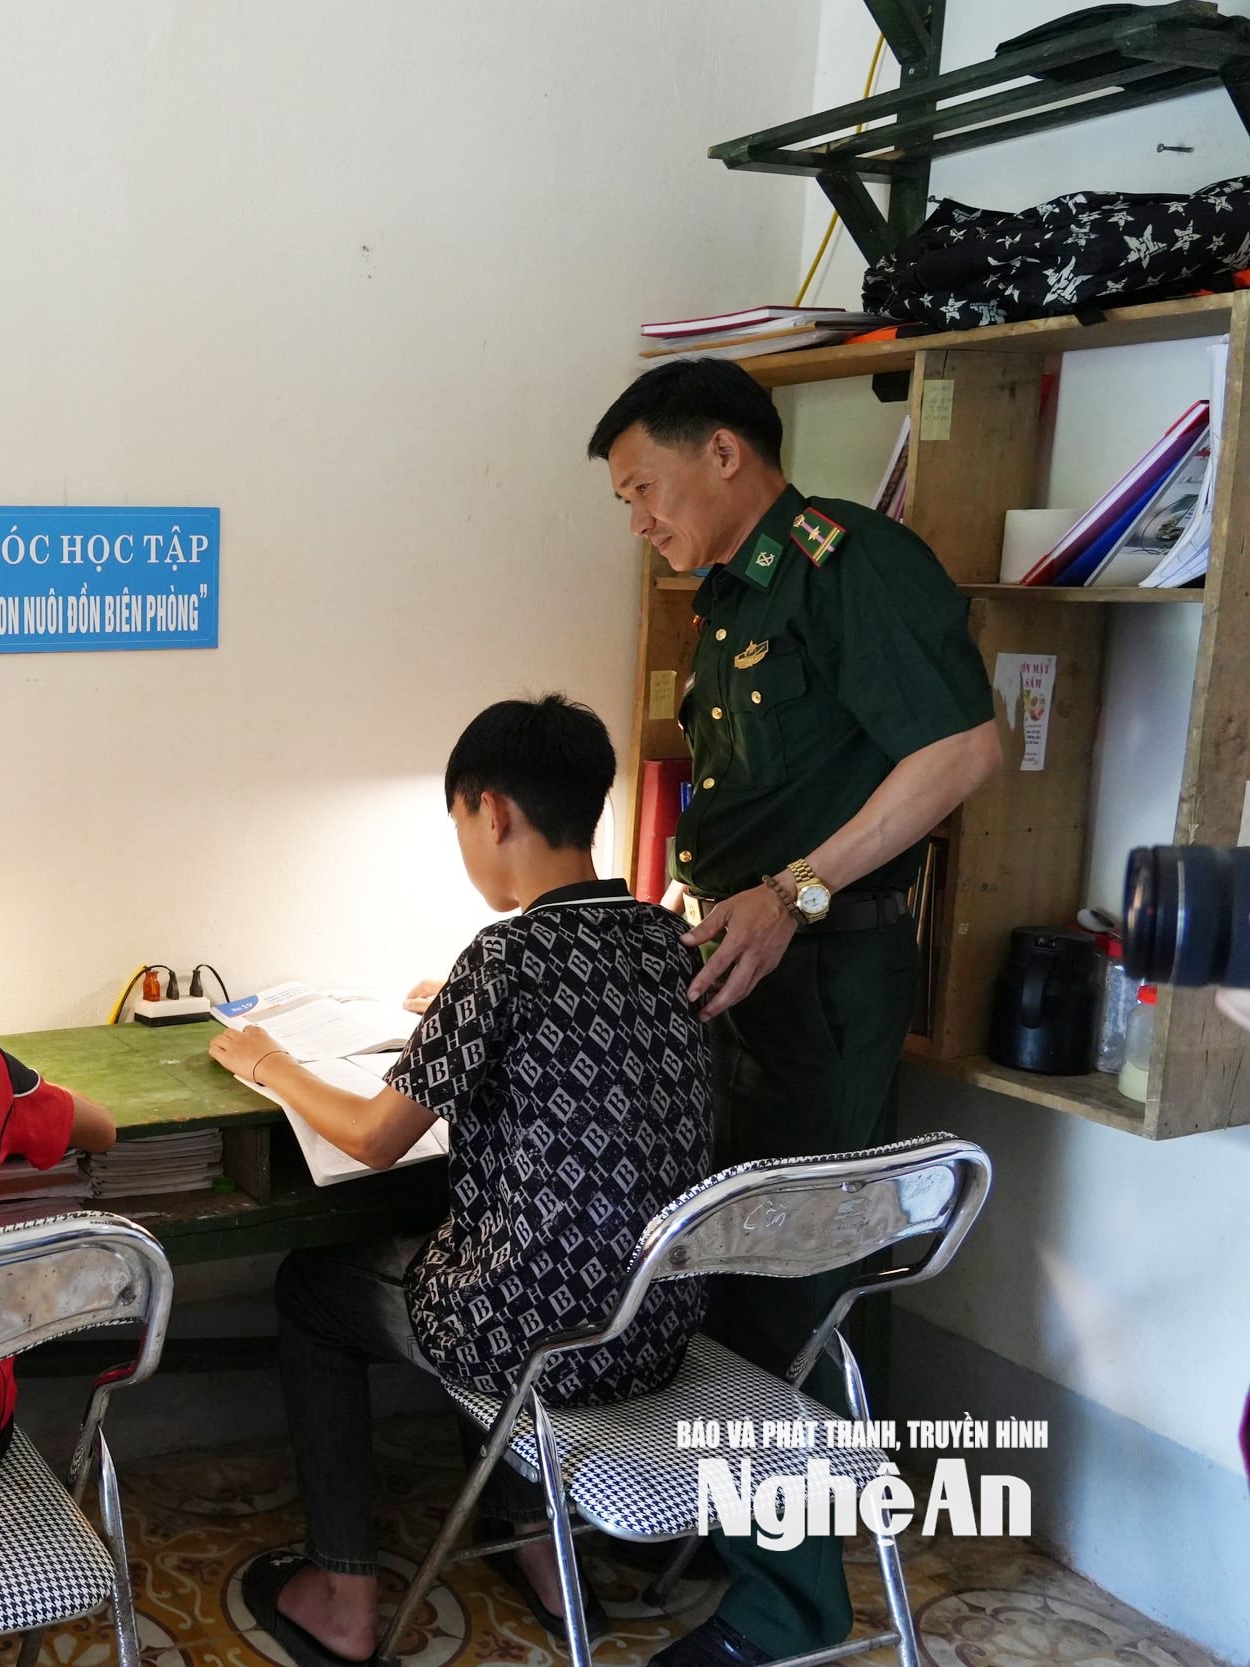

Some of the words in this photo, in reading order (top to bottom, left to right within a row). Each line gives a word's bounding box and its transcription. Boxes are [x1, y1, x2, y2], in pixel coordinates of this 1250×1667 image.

[60, 534, 134, 573] HỌC
[143, 525, 209, 571] TẬP
[23, 588, 63, 634] NUÔI
[67, 582, 101, 634] ĐỒN
[104, 587, 142, 633] BIÊN
[508, 927, 527, 945] H
[534, 926, 553, 947] B
[558, 926, 575, 944] H
[485, 940, 503, 960] B
[667, 949, 679, 970] H
[506, 963, 519, 982] H
[524, 956, 541, 977] B
[548, 953, 565, 976] H
[572, 954, 590, 975] B
[595, 952, 612, 975] H
[646, 958, 662, 976] B
[473, 967, 485, 989] H
[439, 992, 452, 1008] H
[559, 986, 576, 1009] B
[582, 986, 599, 1009] H
[606, 987, 623, 1009] B
[639, 990, 655, 1010] B
[658, 984, 674, 1006] H
[459, 999, 473, 1021] B
[425, 1018, 439, 1039] B
[479, 1010, 495, 1034] H
[616, 1020, 632, 1043] H
[636, 1021, 650, 1044] B
[653, 1020, 667, 1042] H
[673, 1018, 687, 1040] B
[688, 1016, 698, 1036] H
[445, 1030, 460, 1053] H
[541, 1022, 560, 1049] B
[567, 1021, 586, 1046] H
[594, 1021, 611, 1047] B
[410, 1047, 424, 1069] H
[466, 1043, 482, 1066] B
[665, 1053, 680, 1076] B
[685, 1050, 697, 1072] H
[431, 1061, 446, 1081] B
[522, 1059, 540, 1084] B
[546, 1057, 567, 1082] H
[575, 1057, 595, 1084] B
[602, 1056, 620, 1079] H
[626, 1056, 642, 1081] B
[647, 1054, 660, 1078] H
[452, 1073, 468, 1096] H
[415, 1089, 431, 1107] H
[530, 1092, 546, 1115] H
[553, 1093, 573, 1119] B
[579, 1092, 599, 1115] H
[608, 1092, 626, 1117] B
[633, 1089, 648, 1113] H
[652, 1089, 668, 1114] B
[673, 1087, 687, 1109] H
[691, 1086, 704, 1106] B
[462, 1116, 477, 1137] B
[483, 1124, 496, 1140] H
[500, 1115, 511, 1138] B
[533, 1125, 550, 1148] B
[584, 1124, 605, 1151] B
[659, 1124, 673, 1146] H
[678, 1122, 695, 1144] B
[558, 1126, 577, 1150] H
[614, 1126, 632, 1150] H
[637, 1126, 655, 1150] B
[461, 1146, 478, 1168] H
[482, 1152, 495, 1174] B
[499, 1146, 513, 1169] H
[516, 1155, 531, 1178] B
[681, 1157, 695, 1179] H
[536, 1158, 554, 1182] H
[561, 1161, 582, 1184] B
[588, 1162, 609, 1186] H
[615, 1163, 635, 1187] B
[641, 1161, 657, 1184] H
[660, 1160, 676, 1182] B
[458, 1181, 476, 1202] B
[482, 1185, 496, 1207] H
[500, 1182, 510, 1204] B
[518, 1186, 531, 1210] H
[539, 1191, 556, 1216] B
[564, 1194, 582, 1218] H
[589, 1197, 610, 1221] B
[617, 1197, 635, 1221] H
[641, 1199, 658, 1219] B
[457, 1211, 475, 1232] H
[517, 1221, 531, 1244] B
[536, 1226, 554, 1246] H
[561, 1227, 579, 1249] B
[586, 1230, 607, 1253] H
[613, 1232, 632, 1256] B
[482, 1239, 493, 1258] H
[494, 1247, 509, 1265] B
[509, 1251, 525, 1272] H
[532, 1254, 550, 1274] B
[556, 1257, 577, 1281] H
[479, 1272, 495, 1292] H
[583, 1261, 602, 1285] B
[450, 1290, 464, 1310] H
[501, 1279, 520, 1300] B
[526, 1282, 545, 1305] H
[552, 1289, 573, 1312] B
[649, 1288, 664, 1310] B
[471, 1298, 490, 1322] B
[496, 1306, 514, 1323] H
[579, 1293, 598, 1315] H
[520, 1313, 540, 1335] B
[623, 1323, 638, 1342] B
[661, 1314, 678, 1335] B
[490, 1330, 508, 1350] B
[458, 1347, 477, 1362] B
[485, 1357, 501, 1373] H
[567, 1350, 586, 1370] H
[592, 1351, 612, 1372] B
[616, 1350, 634, 1369] H
[458, 1363, 471, 1377] H
[477, 1377, 494, 1390] B
[535, 1374, 553, 1394] H
[562, 1377, 579, 1394] B
